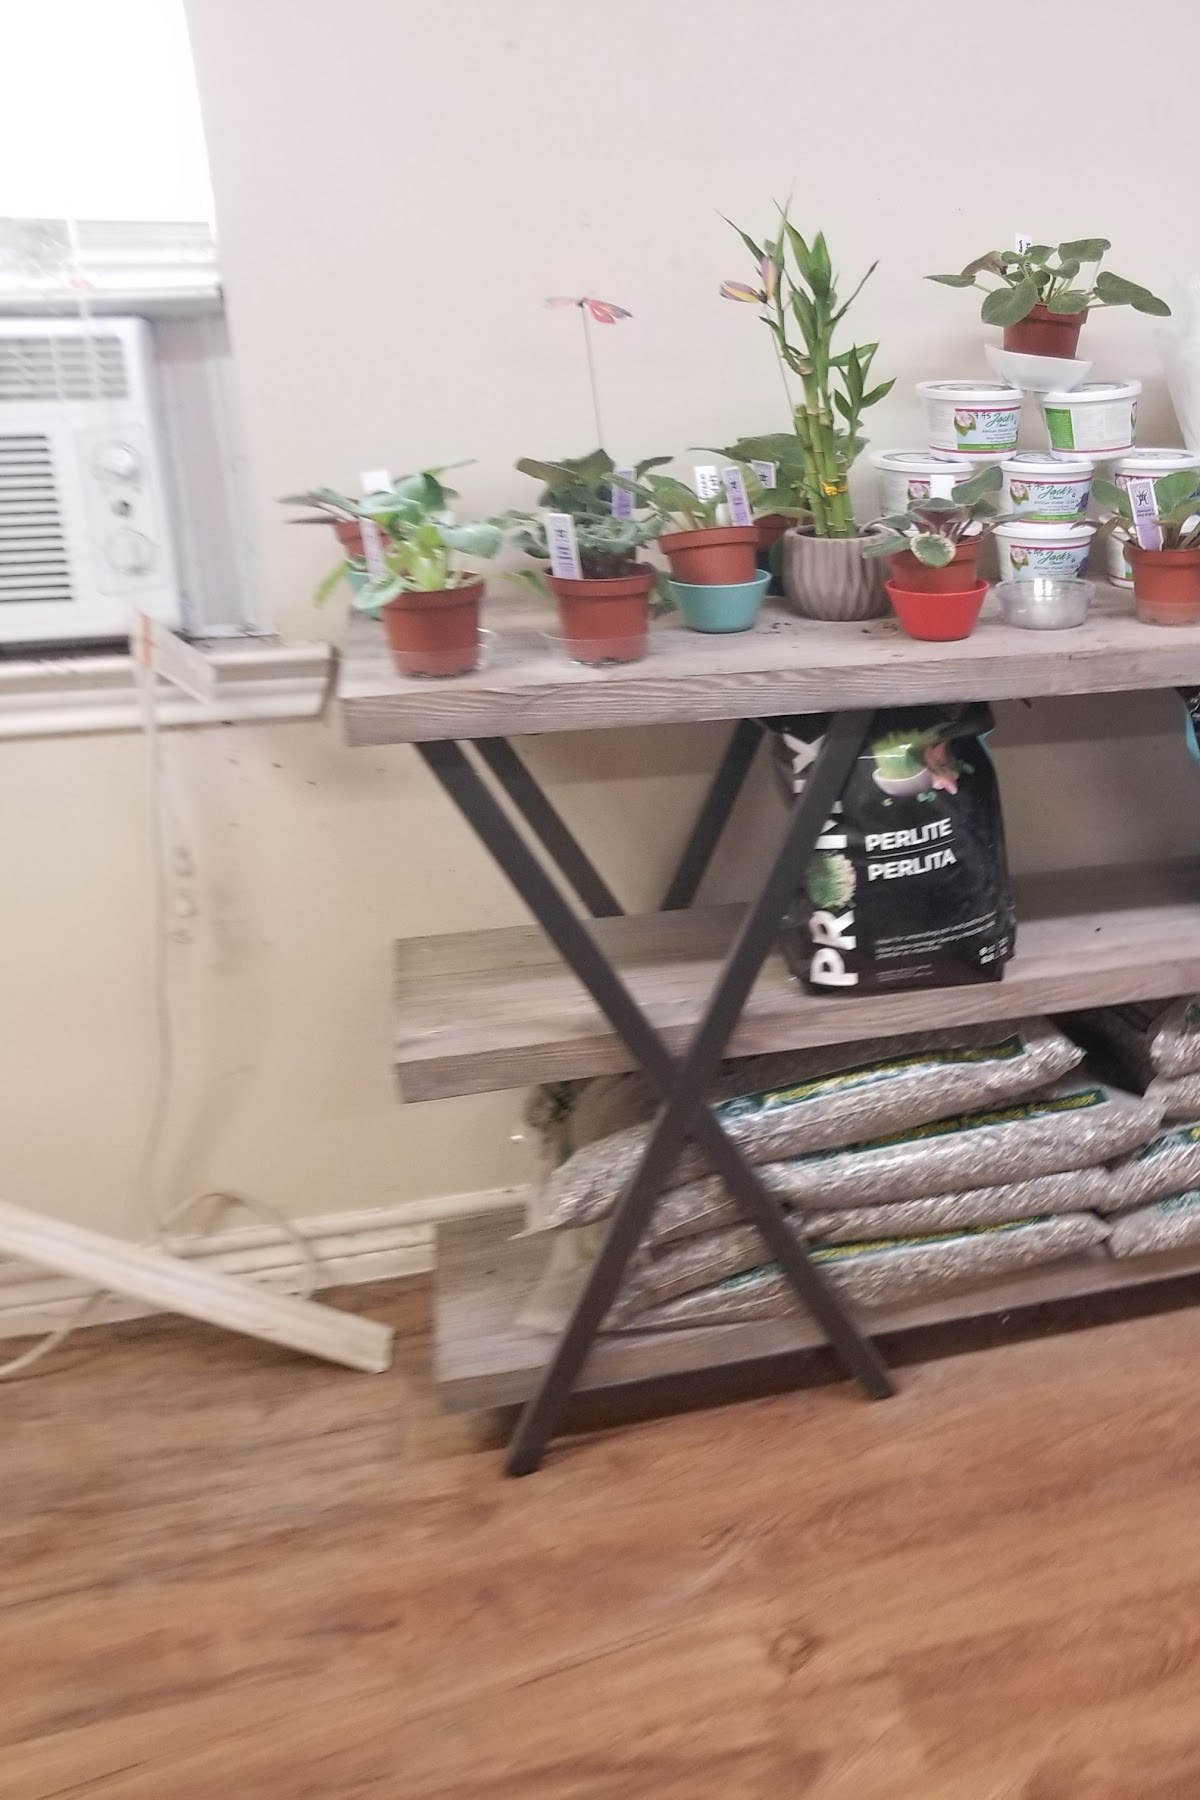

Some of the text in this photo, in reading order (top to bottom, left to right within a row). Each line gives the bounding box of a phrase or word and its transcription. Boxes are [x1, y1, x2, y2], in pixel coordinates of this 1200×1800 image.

[1037, 485, 1073, 500] Jack's
[1037, 550, 1072, 565] Jack's
[864, 816, 954, 852] PERLITE
[867, 847, 959, 882] PERLITA
